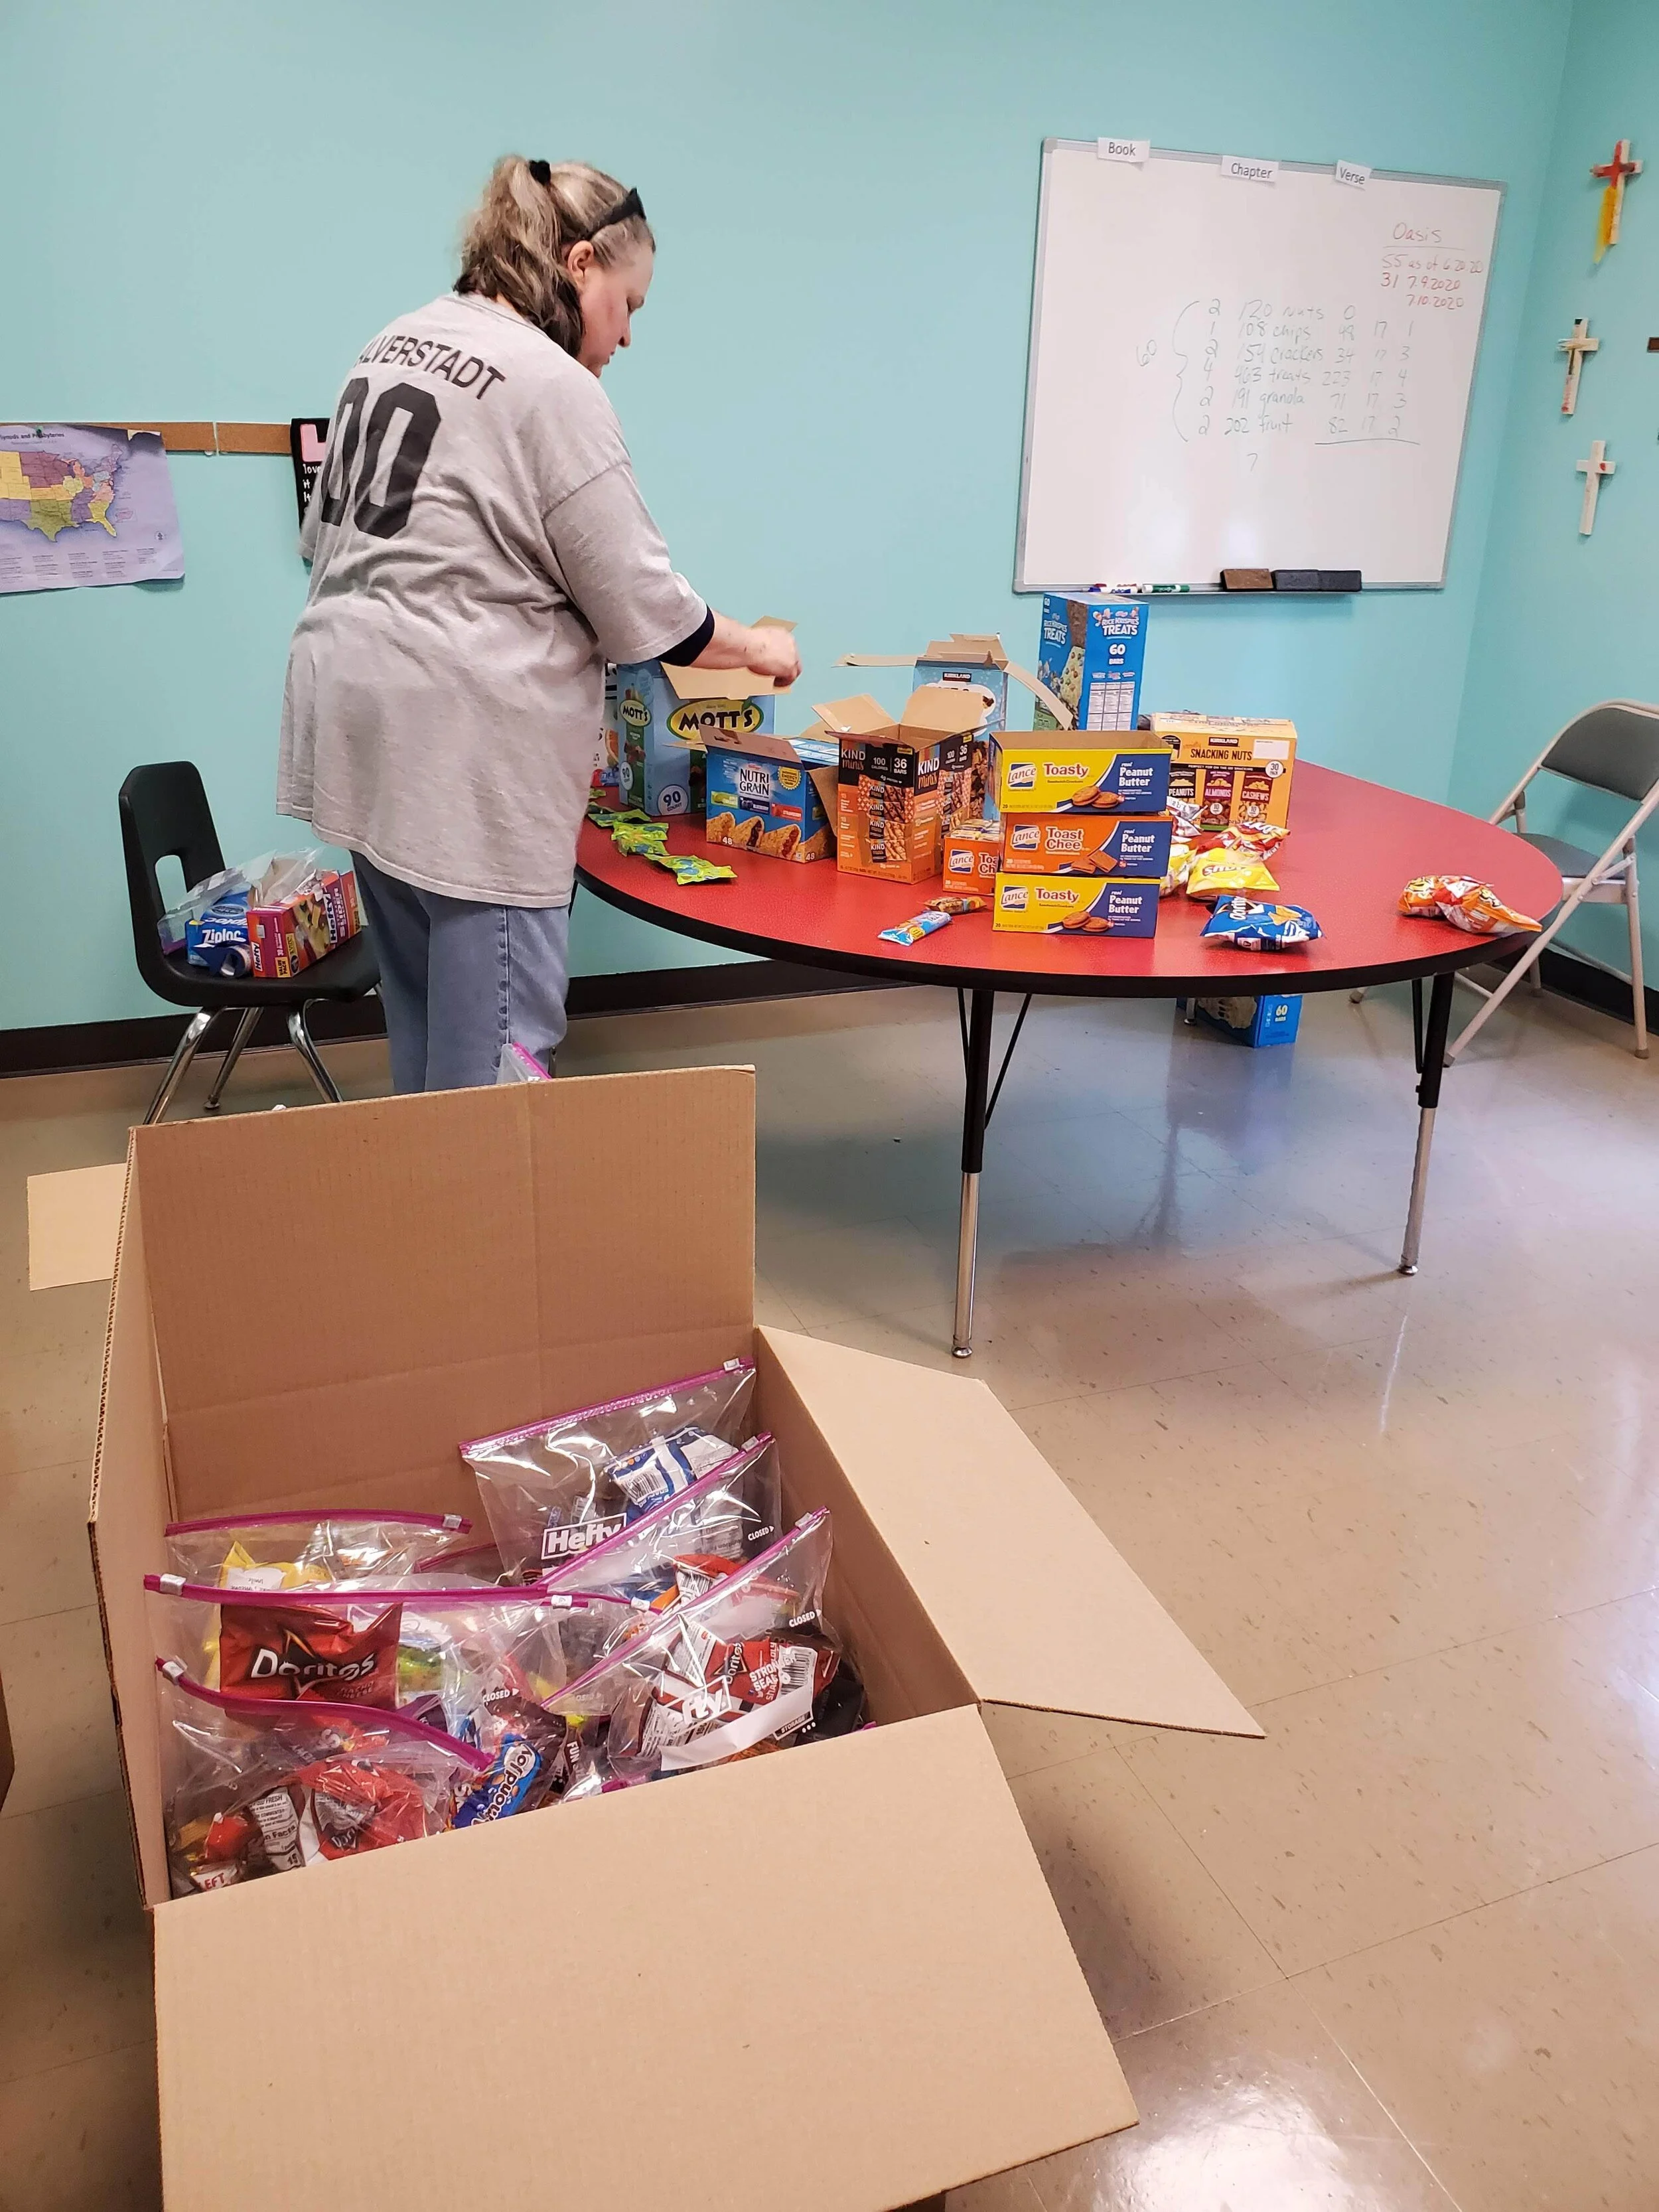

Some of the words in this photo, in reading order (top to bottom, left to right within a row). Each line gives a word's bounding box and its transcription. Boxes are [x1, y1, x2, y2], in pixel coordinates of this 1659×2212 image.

[1108, 142, 1136, 157] Book
[1231, 163, 1272, 181] Chapter
[1340, 167, 1365, 185] Verse
[1393, 222, 1442, 243] Oasis
[1273, 325, 1311, 344] chips
[1260, 388, 1305, 418] granola
[1259, 413, 1293, 433] fruit
[321, 377, 441, 539] 00
[1044, 628, 1066, 644] TREATS
[1102, 625, 1137, 636] TREATS
[1109, 644, 1126, 655] 60
[841, 749, 866, 761] KIND
[873, 757, 886, 766] 100
[894, 758, 908, 769] 36
[918, 757, 940, 776] KIND
[959, 744, 968, 755] 36
[1190, 748, 1229, 760] SNACKING
[1231, 750, 1253, 761] NUTS
[622, 767, 630, 778] 90
[842, 759, 864, 771] minis
[1270, 763, 1279, 771] 30
[740, 769, 769, 783] NUTRI
[918, 772, 937, 790] minis
[1007, 768, 1036, 784] Lance
[1043, 763, 1088, 778] Toasty
[1119, 767, 1153, 776] Peanut
[1119, 776, 1151, 786] Butter
[739, 781, 770, 796] GRAIN
[1169, 788, 1194, 796] PEANUTS
[1204, 788, 1232, 798] ALMONDS
[1242, 790, 1269, 802] CASHEWS
[663, 790, 682, 806] 90
[667, 802, 682, 812] COUNT
[869, 820, 885, 828] KIND
[722, 836, 733, 845] 48
[1011, 830, 1040, 845] Lance
[1047, 828, 1083, 840] Toast
[1121, 834, 1155, 844] Peanut
[1046, 838, 1081, 849] Chee
[1121, 843, 1152, 853] Butter
[806, 852, 815, 861] 48
[950, 855, 974, 867] Lance
[980, 853, 998, 864] Toa
[979, 863, 995, 873] Ch
[1001, 891, 1029, 905] Lance
[1035, 888, 1079, 903] Toasty
[1109, 895, 1143, 905] Peanut
[334, 887, 346, 937] SLIDER
[1108, 904, 1139, 914] Butter
[326, 896, 336, 941] Hefty
[202, 928, 246, 944] Ziploc
[253, 943, 261, 970] Hefty
[1275, 1005, 1288, 1017] 60
[748, 1527, 770, 1542] CLOSED
[789, 1611, 816, 1628] CLOSED
[250, 1648, 376, 1681] Doritos
[482, 1689, 511, 1704] CLOSED
[567, 1741, 580, 1764] FUN
[510, 1747, 534, 1777] Joy
[271, 1825, 297, 1838] Facts
